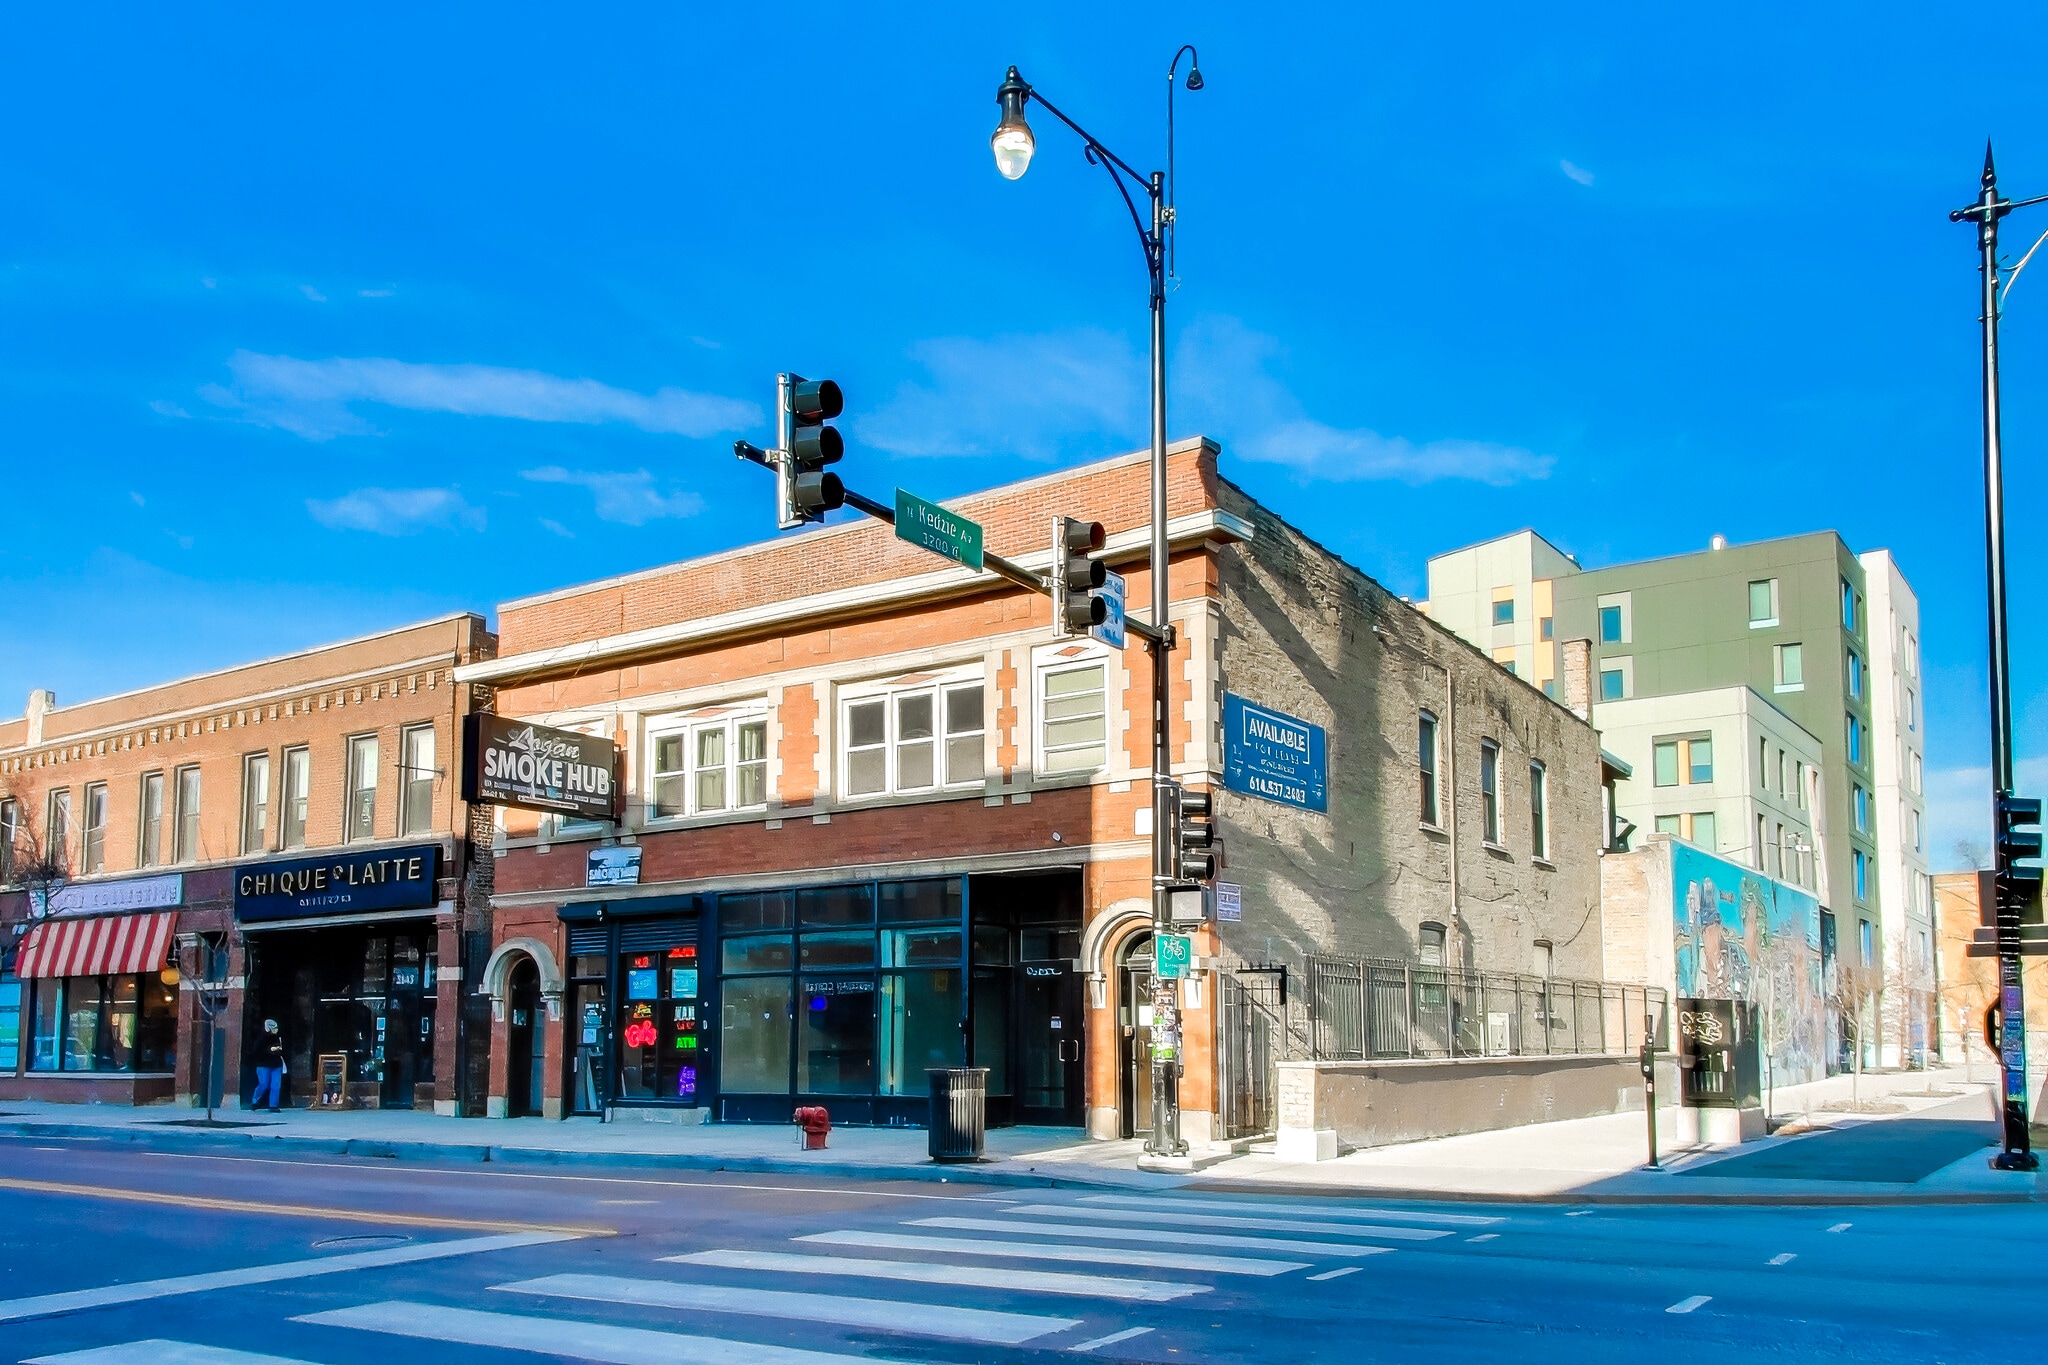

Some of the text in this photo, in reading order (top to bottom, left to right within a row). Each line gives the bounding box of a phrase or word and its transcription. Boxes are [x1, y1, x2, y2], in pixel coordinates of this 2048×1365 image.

[918, 504, 957, 538] Kedzie
[922, 532, 949, 553] 3200
[1248, 717, 1306, 752] AVAILABLE
[484, 747, 563, 788] SMOKE
[566, 762, 610, 795] HUB
[240, 867, 327, 897] CHIQUE
[349, 856, 421, 886] LATTE
